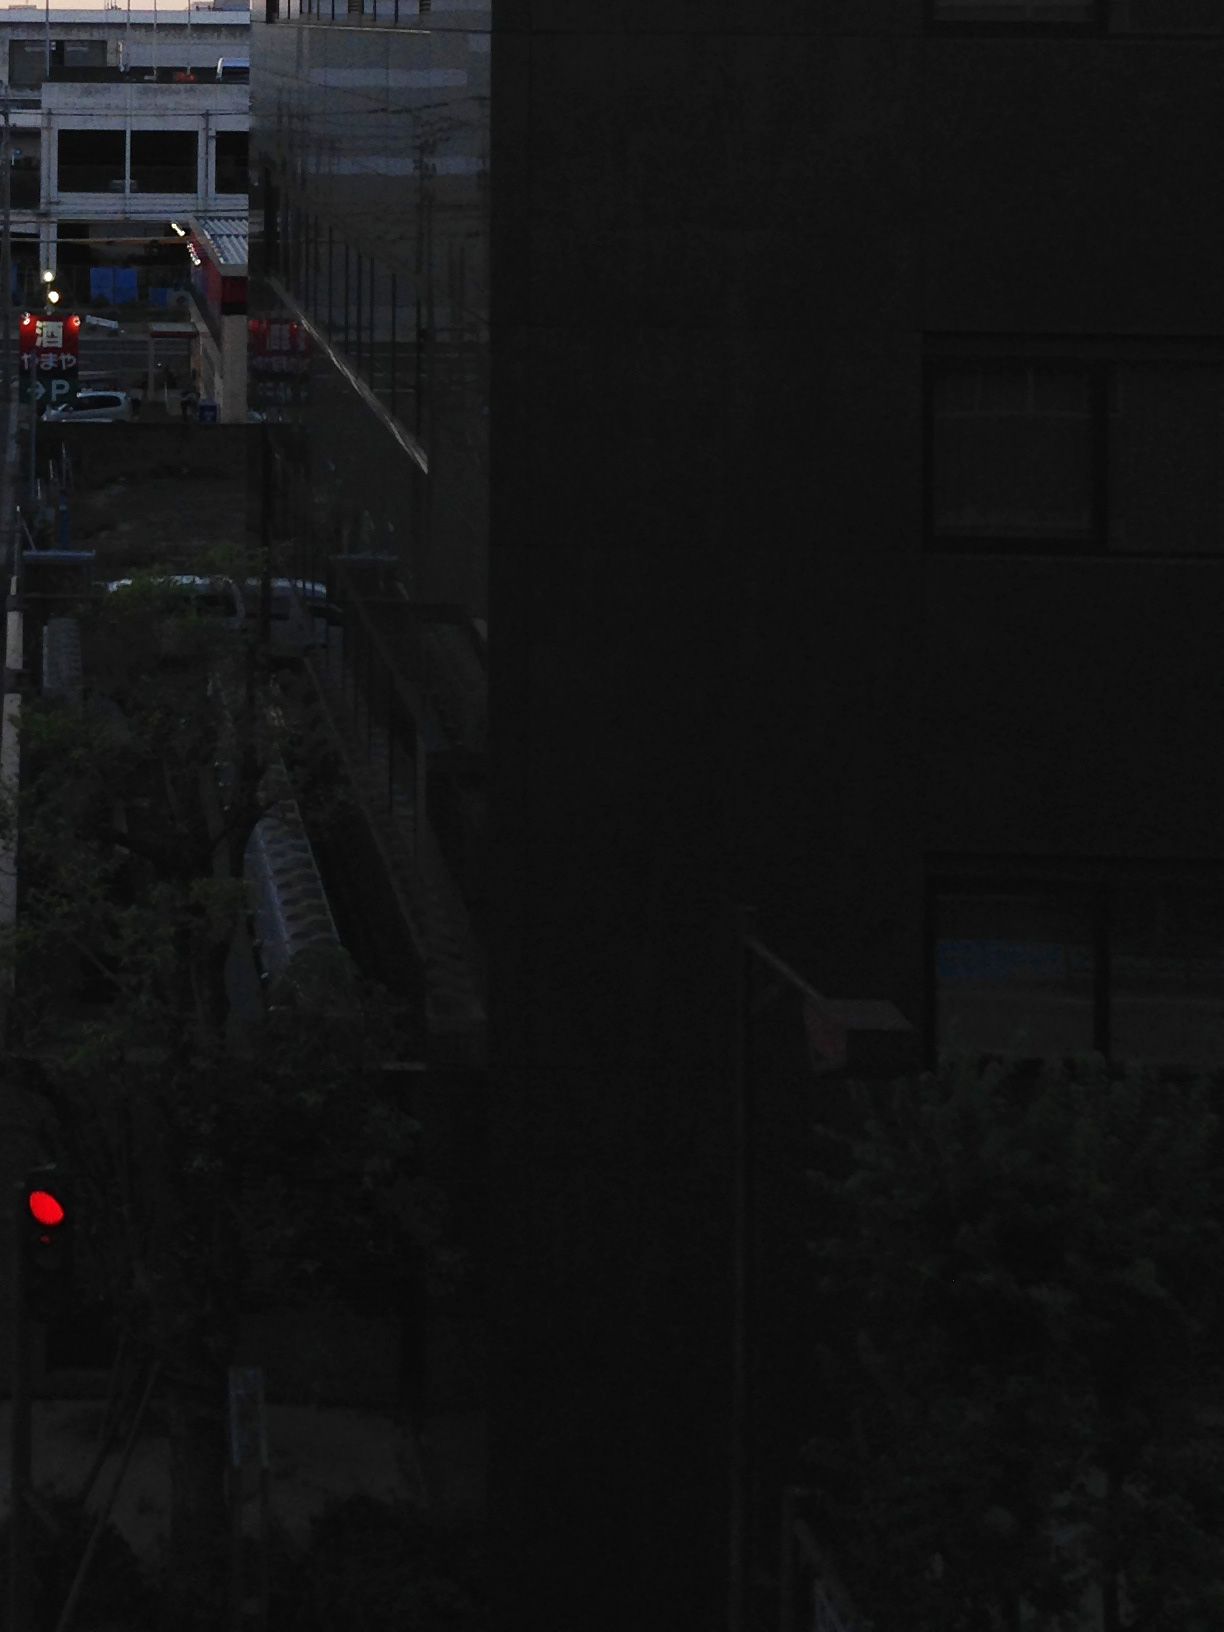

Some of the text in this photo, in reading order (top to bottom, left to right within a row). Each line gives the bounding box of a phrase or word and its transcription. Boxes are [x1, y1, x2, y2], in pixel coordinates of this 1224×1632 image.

[35, 320, 64, 348] 酒
[20, 352, 77, 371] やまや
[51, 379, 71, 402] P
